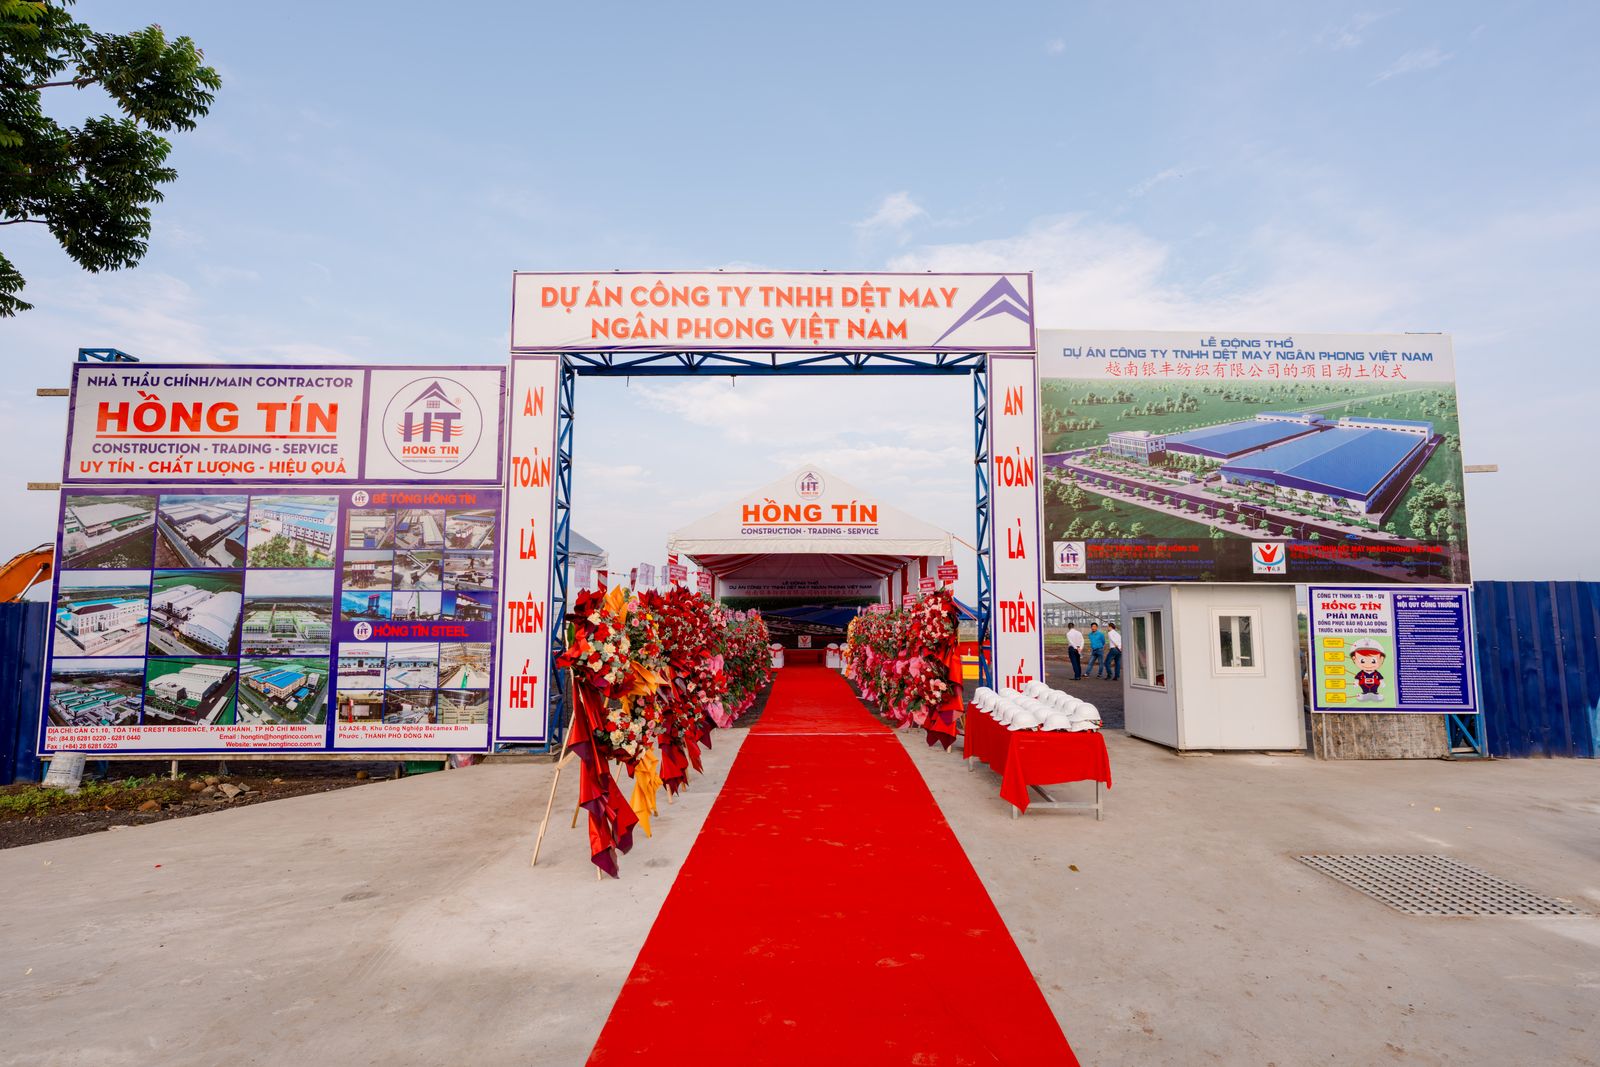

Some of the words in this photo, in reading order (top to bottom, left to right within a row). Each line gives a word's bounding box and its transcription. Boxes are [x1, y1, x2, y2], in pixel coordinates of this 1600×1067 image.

[542, 287, 580, 313] DỰ
[586, 281, 623, 306] ÁN
[630, 280, 710, 307] CÔNG
[718, 286, 751, 307] TY
[759, 286, 833, 307] TNHH
[841, 281, 891, 313] DỆT
[899, 287, 958, 307] MAY
[591, 312, 669, 339] NGÂN
[677, 317, 774, 339] PHONG
[781, 312, 841, 344] VIỆT
[848, 318, 908, 339] NAM
[1201, 336, 1217, 347] LỄ
[1221, 338, 1260, 350] ĐỘNG
[1265, 336, 1294, 348] THỔ
[1063, 347, 1082, 359] DỰ
[1086, 346, 1106, 358] ÁN
[1110, 347, 1147, 358] CÔNG
[1150, 349, 1168, 359] TY
[1173, 350, 1209, 360] TNHH
[1213, 348, 1239, 361] DỆT
[1242, 351, 1272, 360] MAY
[1276, 349, 1315, 361] NGÂN
[1319, 352, 1365, 361] PHONG
[1369, 350, 1397, 363] VIỆT
[1402, 352, 1433, 361] NAM
[88, 374, 118, 387] NHÀ
[122, 371, 161, 387] THẦU
[163, 374, 253, 387] CHÍNH/MAIN
[256, 376, 354, 388] CONTRACTOR
[1105, 361, 1407, 380] 越南银丰纺织有限公司的项目动土仪式
[97, 391, 239, 433] HỒNG
[257, 395, 339, 433] TÍN
[523, 386, 544, 417] AN
[1003, 385, 1024, 416] AN
[92, 443, 200, 454] CONSTRUCTION
[211, 443, 271, 454] TRADING
[282, 443, 338, 454] SERVICE
[402, 445, 436, 454] HONG
[440, 445, 459, 454] TIN
[80, 460, 104, 473] UY
[107, 458, 135, 473] TÍN
[148, 455, 194, 473] CHẤT
[197, 460, 255, 476] LƯỢNG
[269, 458, 308, 476] HIỆU
[311, 456, 347, 476] QUẢ
[512, 447, 551, 488] TOÀN
[995, 446, 1034, 487] TOÀN
[742, 497, 823, 523] HỒNG
[831, 500, 878, 523] TÍN
[519, 518, 537, 560] LÀ
[741, 527, 802, 535] CONSTRUCTION
[808, 527, 842, 535] TRADING
[847, 527, 879, 535] SERVICE
[1007, 518, 1026, 560] LÀ
[508, 592, 544, 633] TRÊN
[999, 590, 1036, 633] TRÊN
[1360, 601, 1382, 611] TÍN
[431, 625, 470, 637] STEEL
[509, 659, 538, 709] HẾT
